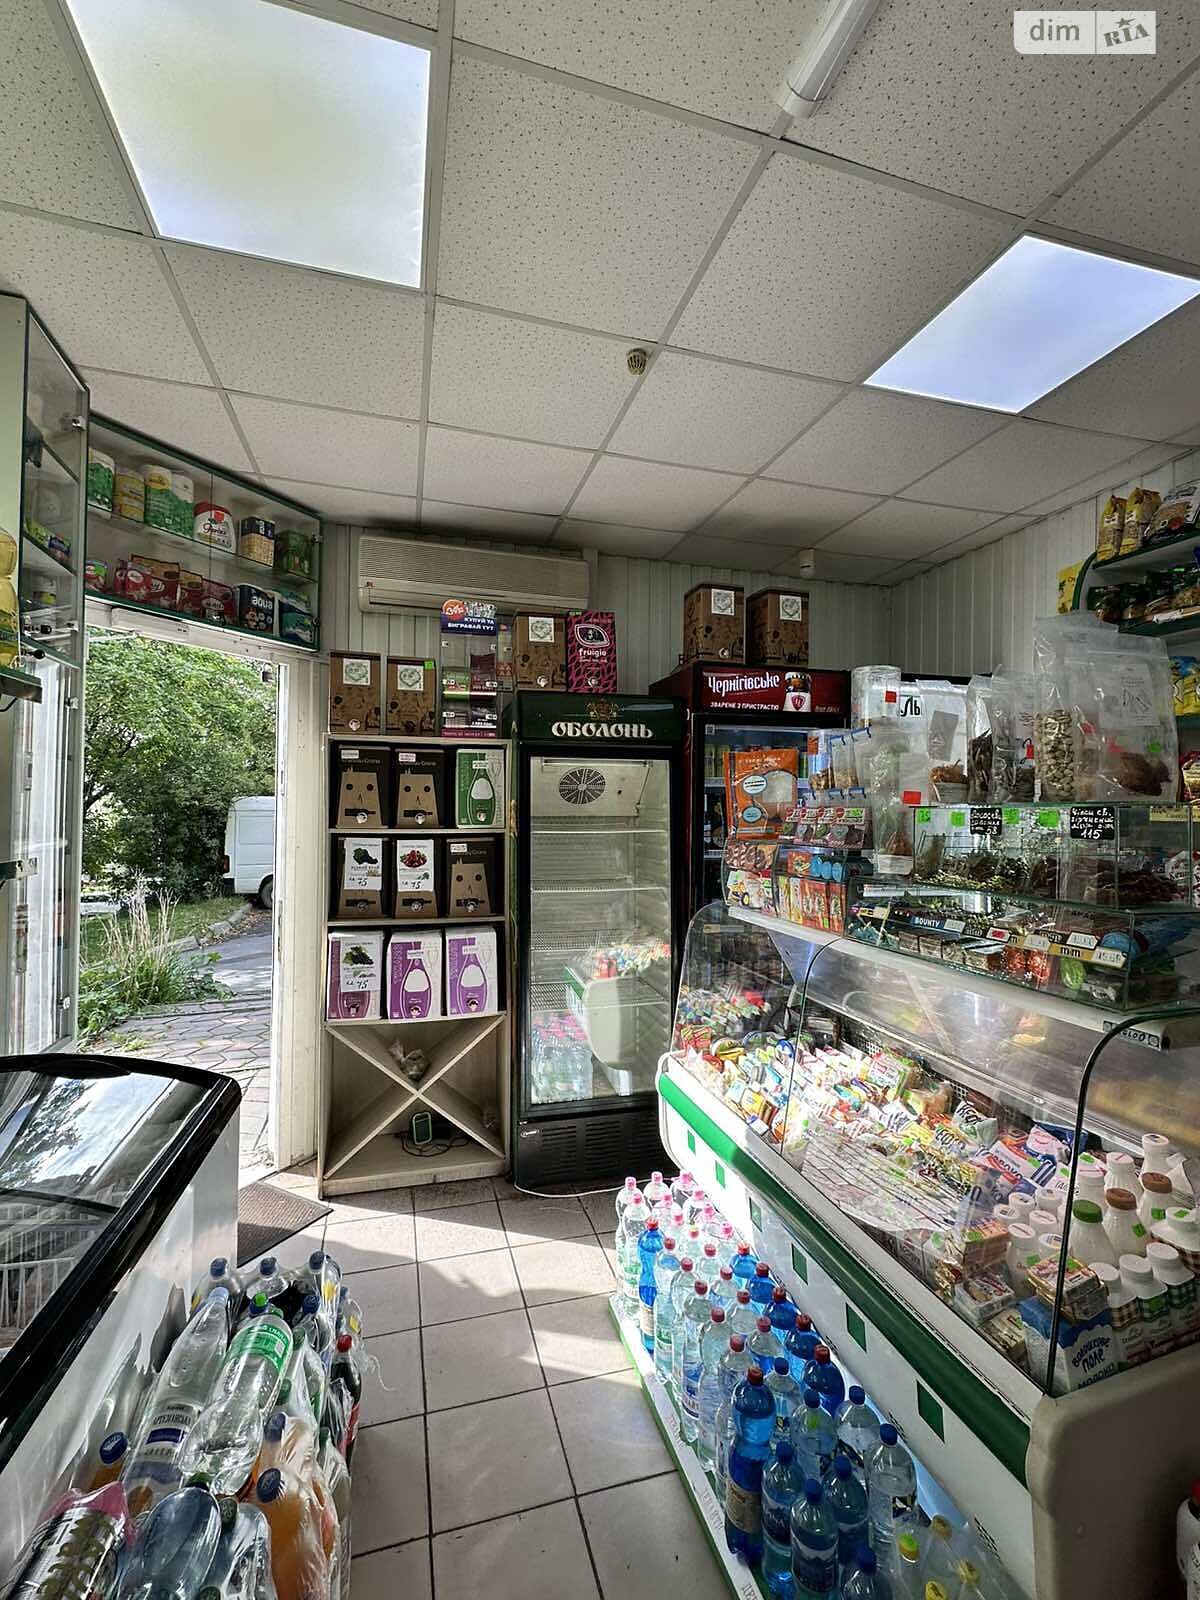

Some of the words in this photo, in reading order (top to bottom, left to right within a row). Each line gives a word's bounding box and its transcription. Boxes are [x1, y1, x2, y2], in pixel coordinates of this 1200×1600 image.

[708, 672, 780, 697] Чернігівське
[710, 701, 737, 709] ЗВАРЕНЕ
[741, 703, 779, 711] ПРИСТРАСТЮ
[551, 721, 654, 739] ОБОЛОНЬ
[915, 916, 940, 927] BOUNTY
